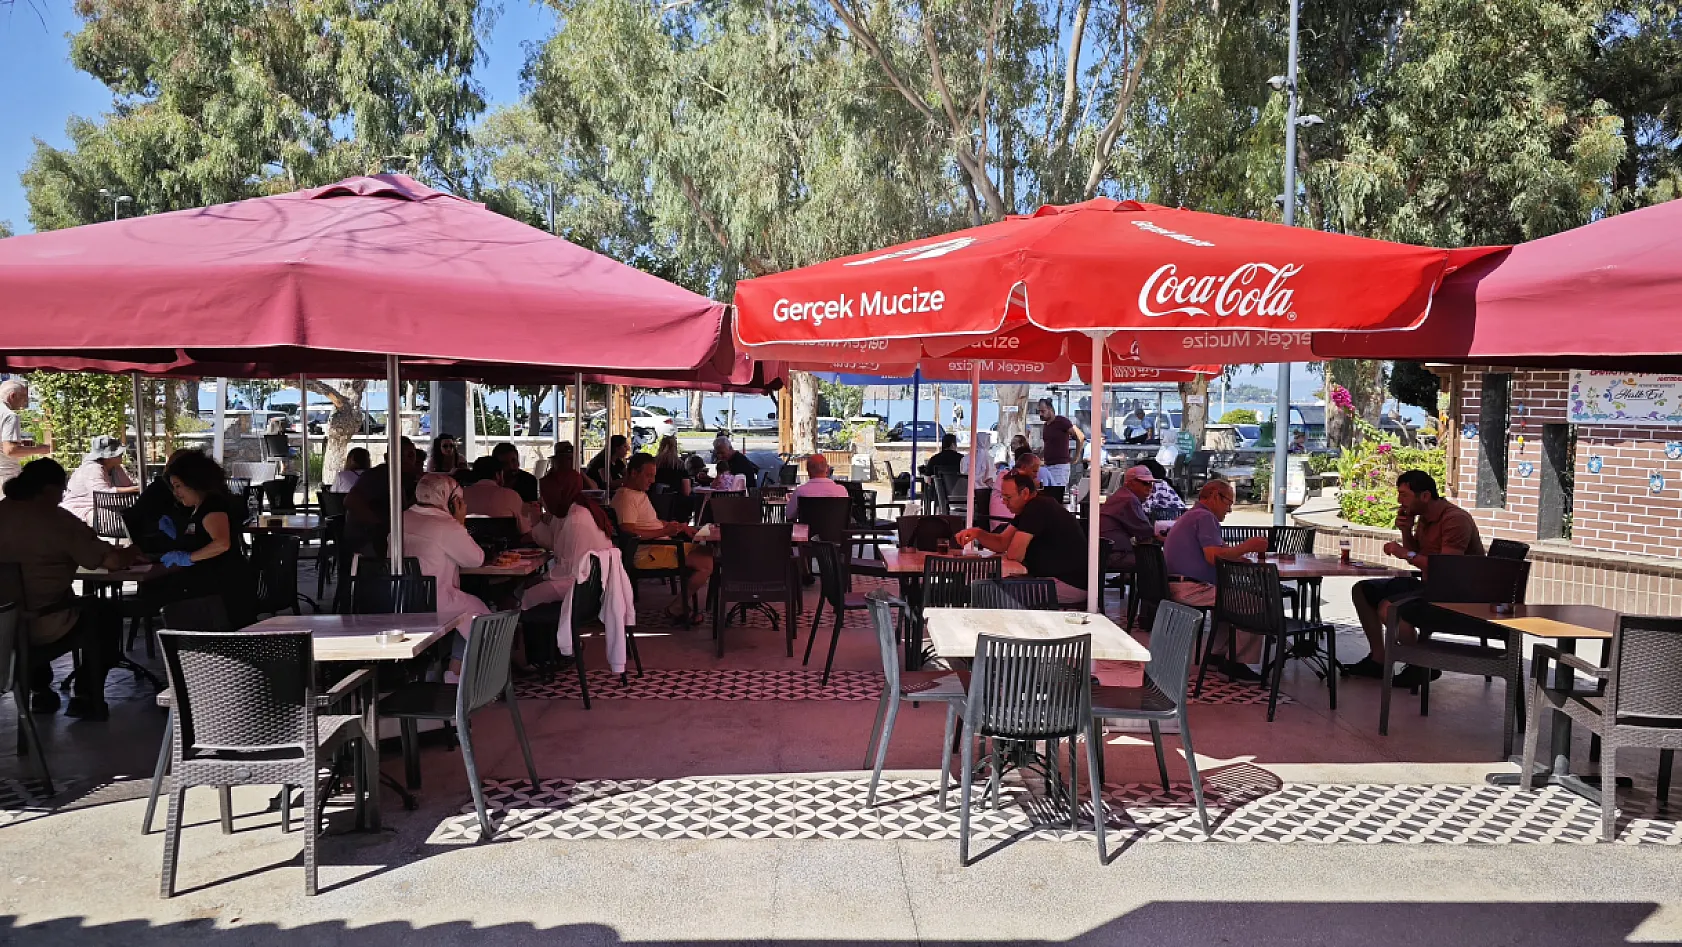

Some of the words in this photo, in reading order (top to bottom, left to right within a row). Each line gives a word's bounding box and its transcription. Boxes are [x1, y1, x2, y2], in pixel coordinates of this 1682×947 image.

[773, 293, 853, 327] Gerçek
[859, 286, 946, 317] Mucize
[1138, 262, 1304, 318] Coca-Cola
[970, 336, 1020, 349] ucize
